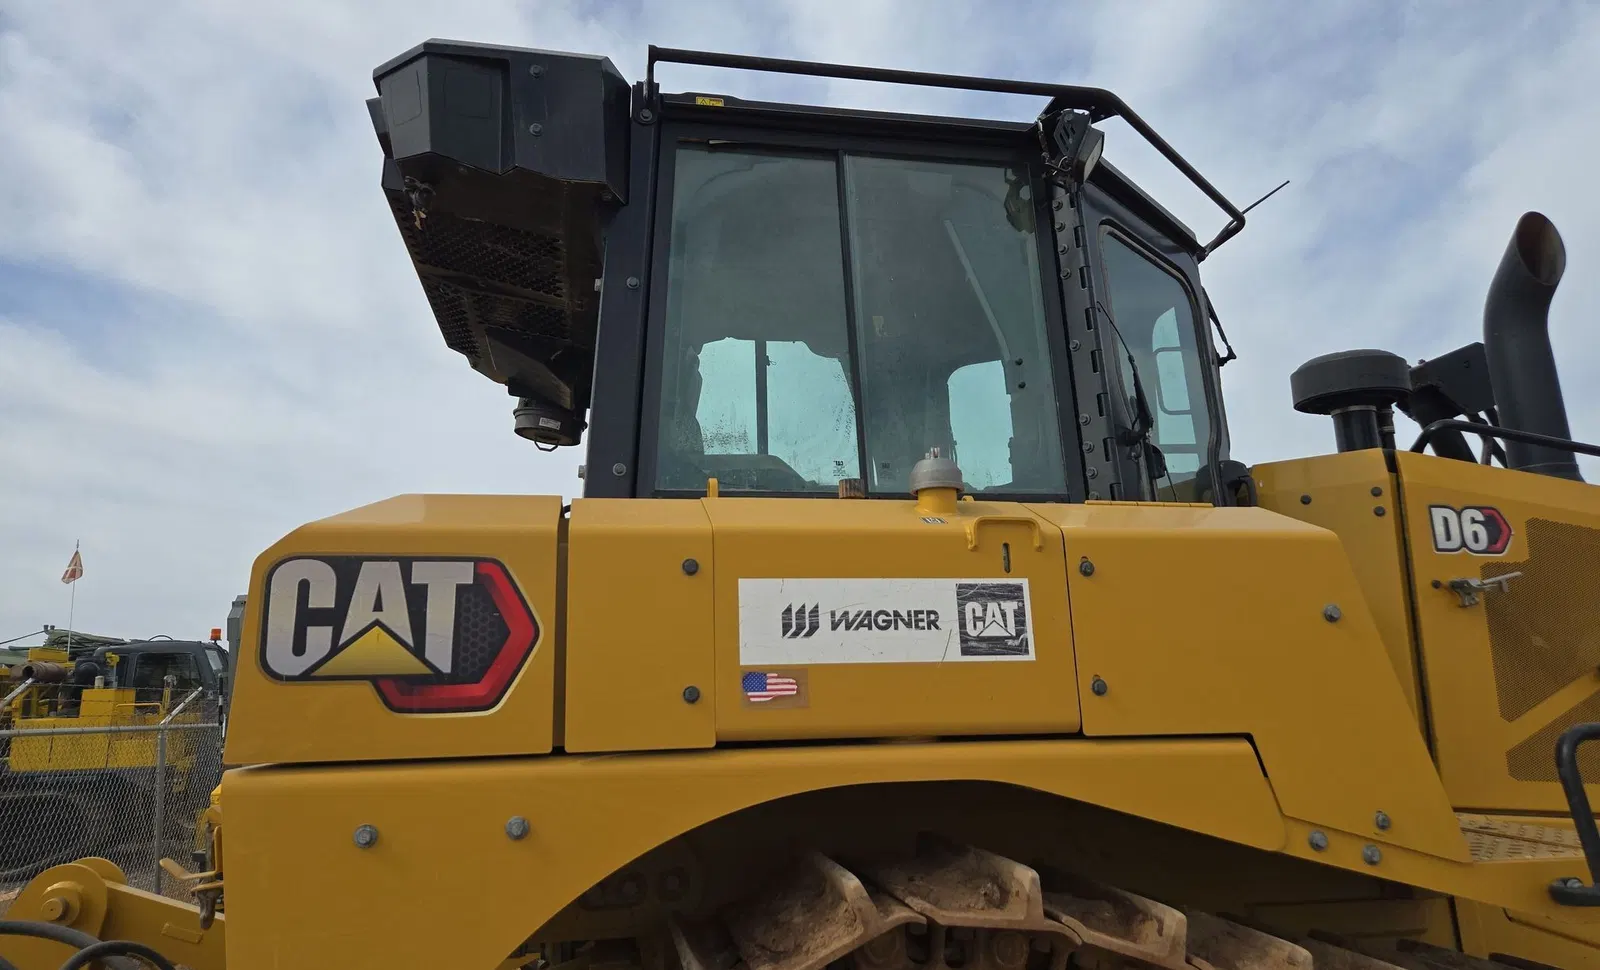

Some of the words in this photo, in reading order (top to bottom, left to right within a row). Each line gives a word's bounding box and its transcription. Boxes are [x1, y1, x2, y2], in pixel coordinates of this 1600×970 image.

[1431, 508, 1489, 551] D6
[266, 558, 474, 676] CAT
[830, 609, 941, 632] WAGNER
[965, 601, 1018, 637] CAT
